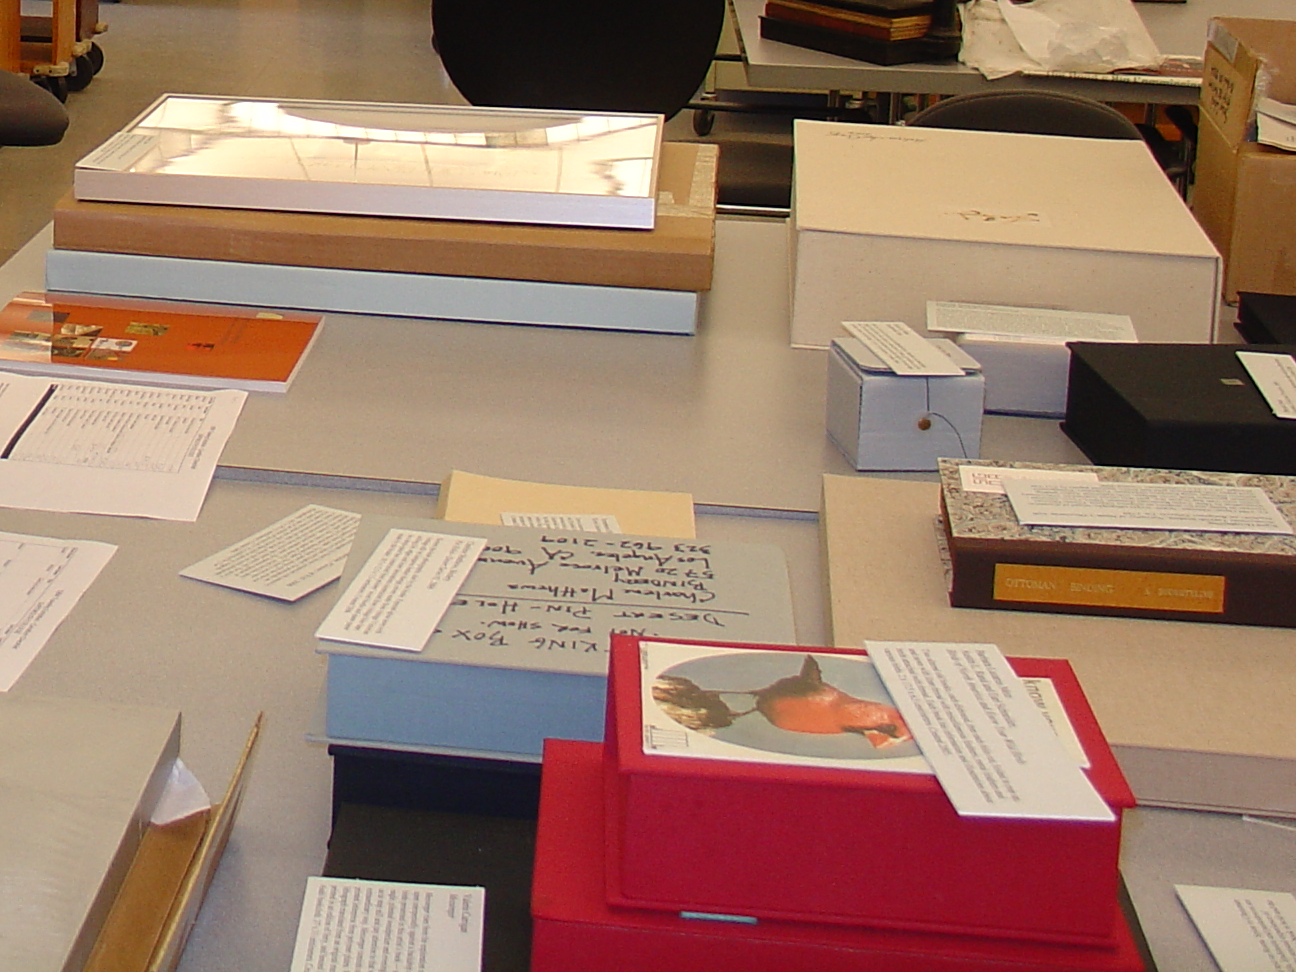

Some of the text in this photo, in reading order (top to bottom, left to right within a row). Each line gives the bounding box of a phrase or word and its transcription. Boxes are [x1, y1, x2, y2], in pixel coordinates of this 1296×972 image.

[540, 546, 575, 560] CA
[673, 542, 712, 555] 323
[1005, 578, 1057, 591] OTTOMAN
[451, 628, 608, 652] KING BOX
